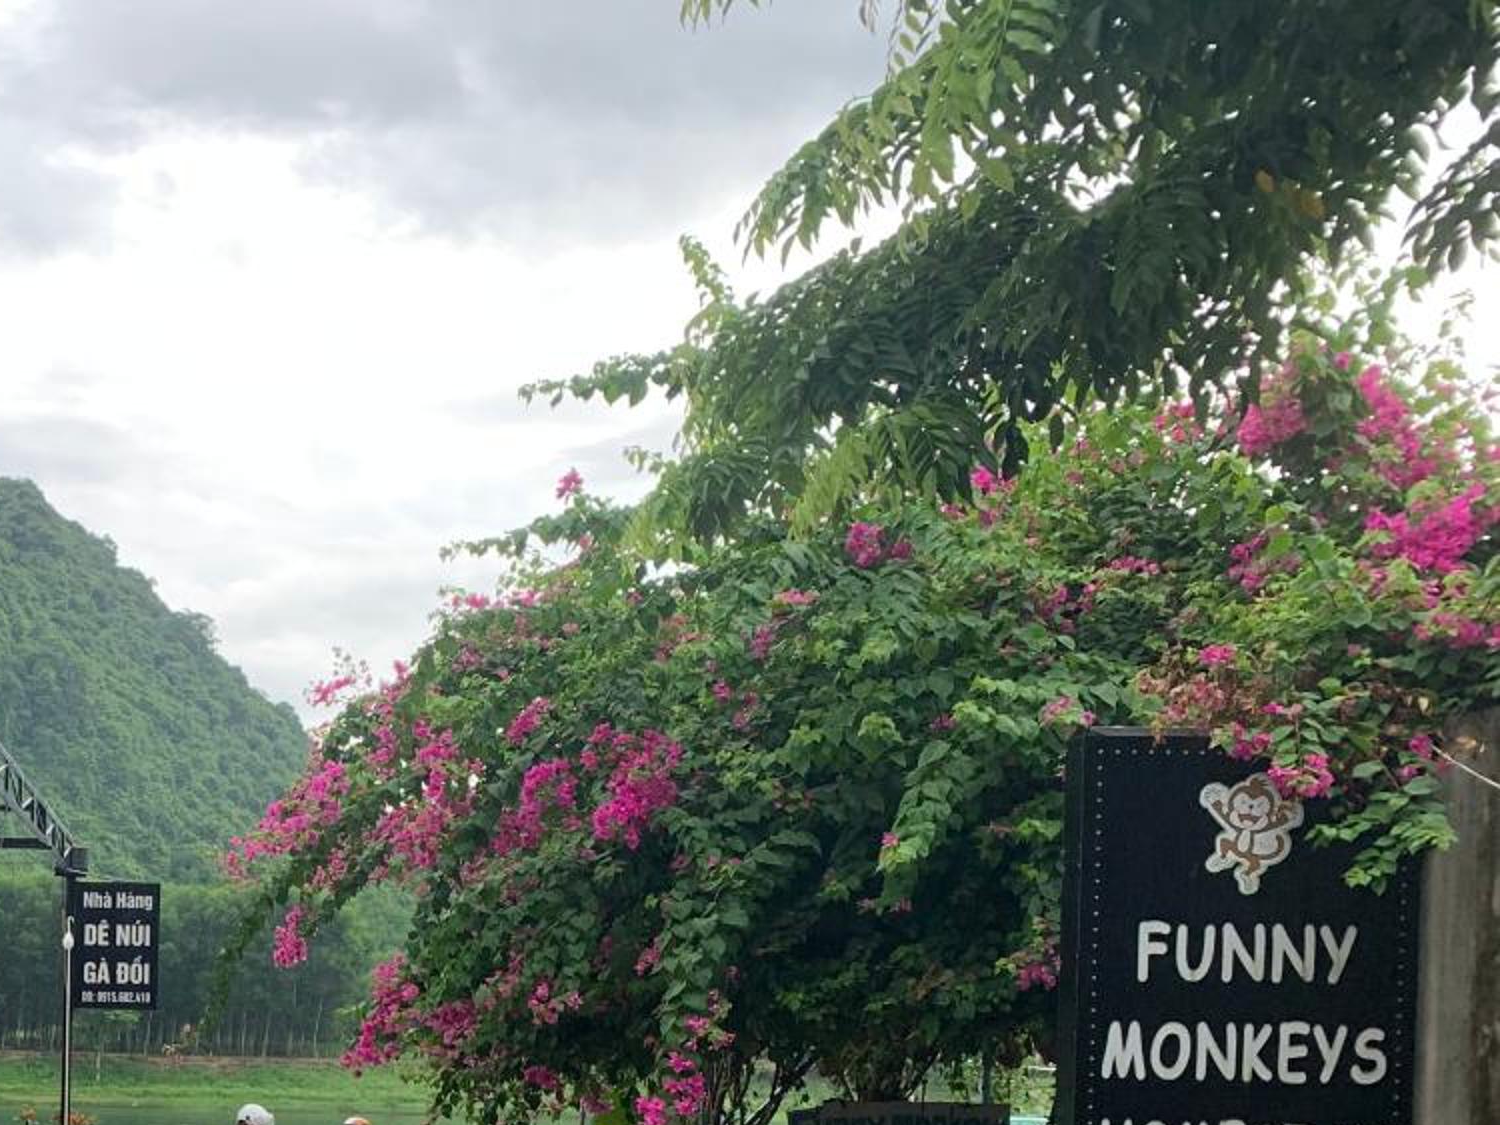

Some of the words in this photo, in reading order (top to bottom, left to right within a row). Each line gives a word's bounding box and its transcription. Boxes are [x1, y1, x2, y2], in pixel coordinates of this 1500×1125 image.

[84, 919, 110, 947] DÊ
[116, 920, 151, 947] NÚI
[1137, 920, 1358, 984] FUNNY
[1101, 1020, 1387, 1085] MONKEYS
